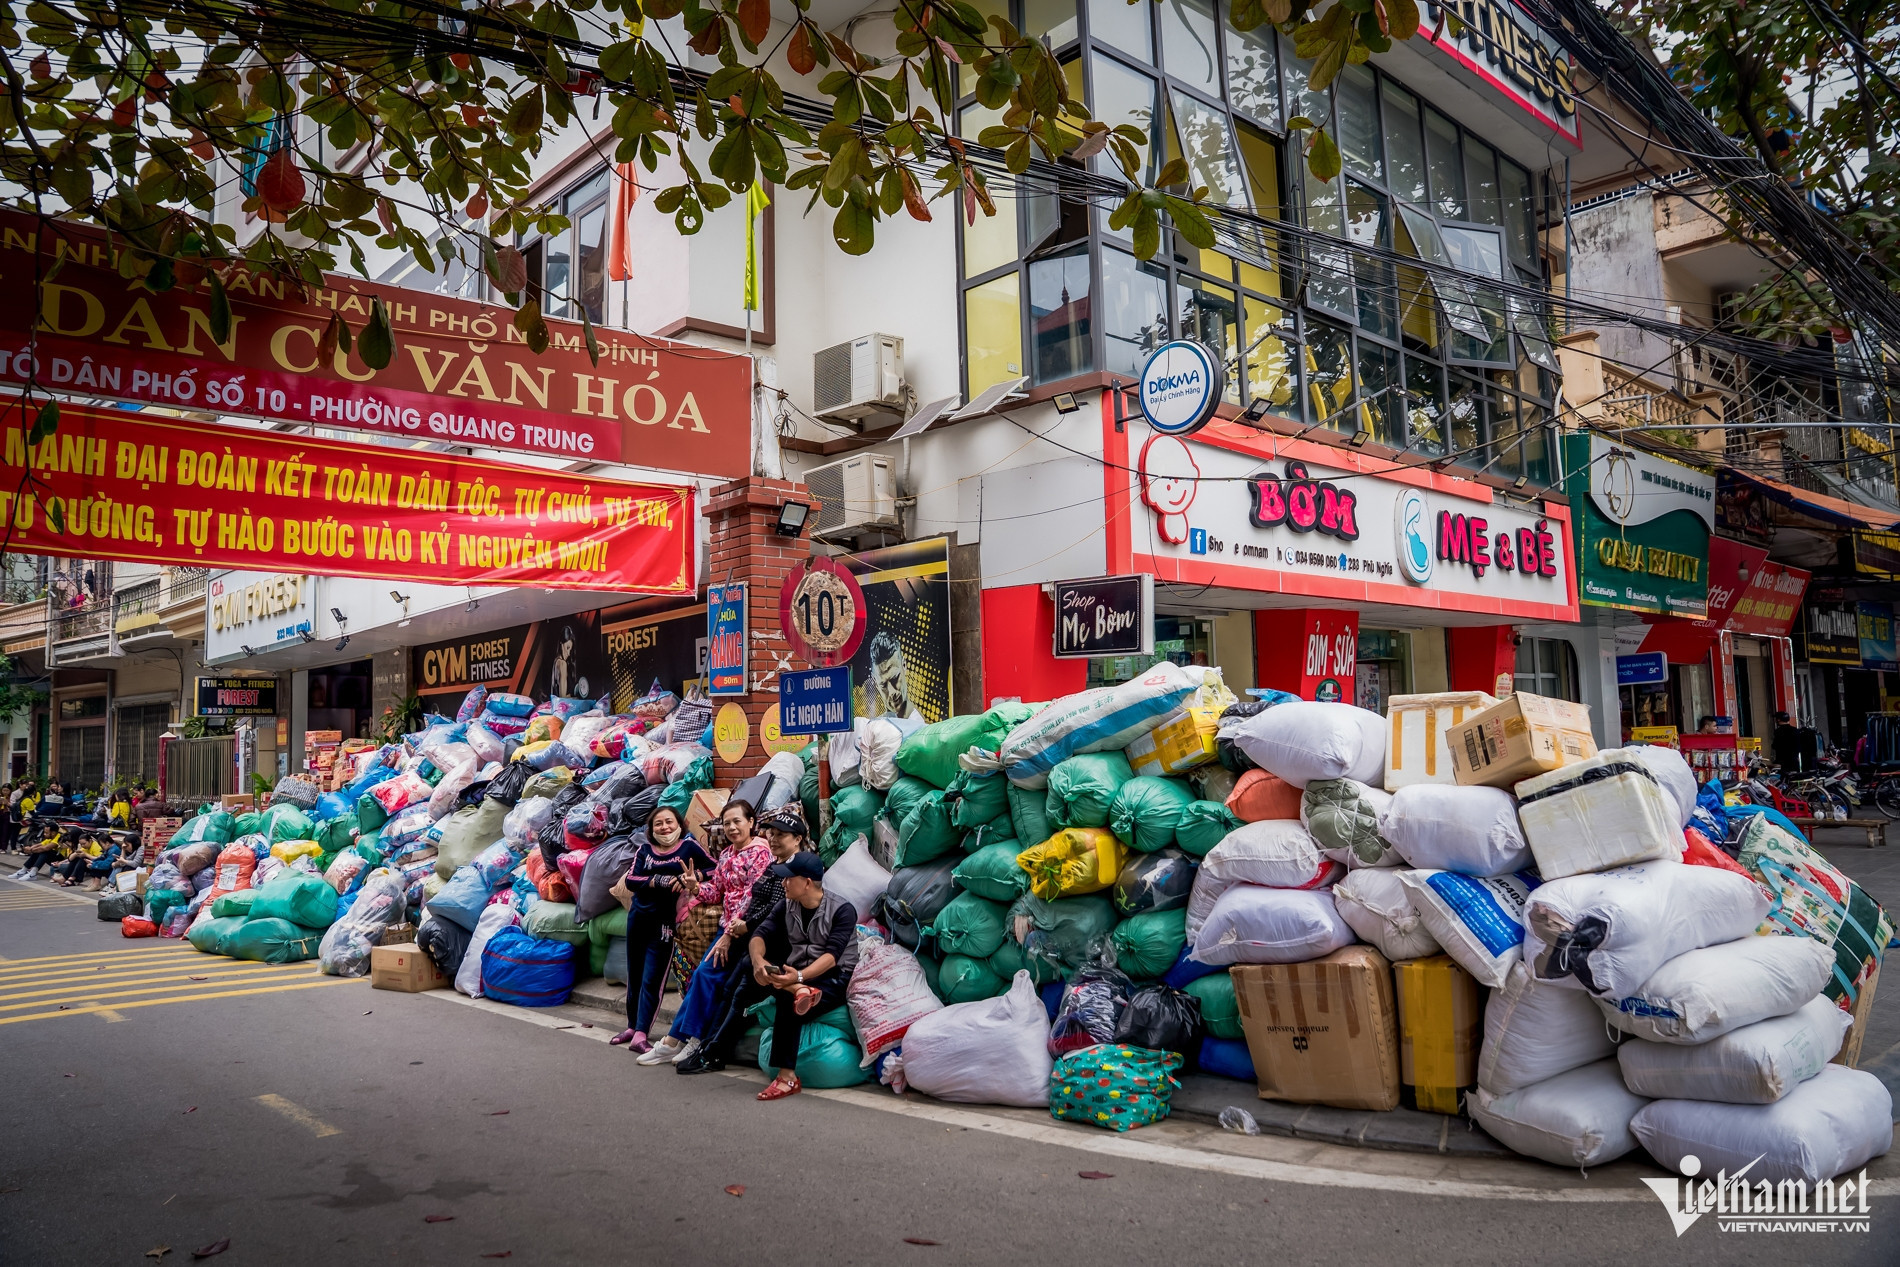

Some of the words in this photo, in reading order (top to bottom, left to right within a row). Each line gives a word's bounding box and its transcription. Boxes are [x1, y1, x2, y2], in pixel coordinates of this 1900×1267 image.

[1428, 0, 1576, 118] ITNESS
[430, 311, 498, 338] PHỐ
[507, 322, 580, 353] NM
[31, 278, 246, 362] DÂN
[404, 340, 556, 410] VĂN
[572, 370, 712, 435] HÓA
[51, 355, 121, 392] DÂN
[132, 367, 199, 398] PHỐ
[206, 374, 246, 407] SỐ
[256, 386, 286, 413] 10
[310, 395, 421, 430] PHƯỜNG
[429, 411, 516, 442] QUANG
[523, 424, 595, 453] TRUNG
[6, 426, 107, 480] MẠNH
[116, 440, 168, 491] ĐẠI
[177, 445, 259, 499] ĐOÀN
[265, 452, 316, 499] KẾT
[323, 463, 392, 507] TOÀN
[397, 470, 452, 514] DÂN
[457, 477, 506, 525] TỘC,
[514, 487, 546, 528] TỰ
[548, 484, 599, 529] CHỦ,
[603, 496, 633, 534] TỰ
[1248, 460, 1360, 542] BỜM
[0, 490, 39, 539] TỰ
[46, 490, 164, 548] CƯỜNG,
[173, 508, 213, 555] TỰ
[218, 507, 276, 551] HÀO
[283, 514, 355, 559] BƯỚC
[362, 520, 412, 564] VÀO
[420, 521, 452, 566] KỶ
[459, 533, 553, 570] NGUYÊN
[1436, 509, 1491, 579] MẸ
[1494, 531, 1515, 572] &
[1515, 517, 1558, 578] BÉ
[212, 588, 244, 632] GYM
[244, 573, 308, 620] FOREST
[1062, 588, 1096, 611] Shop
[1707, 584, 1735, 610] ttel
[716, 608, 736, 622] HỮA
[1062, 613, 1091, 650] Mẹ
[1095, 603, 1136, 640] Bờm
[608, 626, 658, 654] FOREST
[711, 626, 742, 669] RĂNG
[424, 644, 467, 686] GYM
[470, 638, 510, 662] FOREST
[470, 658, 510, 682] FITNESS
[202, 680, 217, 688] GYM
[248, 680, 275, 688] FITNESS
[723, 676, 738, 685] 50m
[804, 676, 832, 692] ĐƯỜNG
[217, 689, 260, 706] FOREST
[786, 700, 797, 728] LÊ
[798, 704, 823, 730] NGỌC
[824, 698, 844, 724] HÂN
[717, 722, 746, 742] GYM
[1266, 1025, 1295, 1035] bassini
[1297, 1025, 1329, 1036] arnaldo
